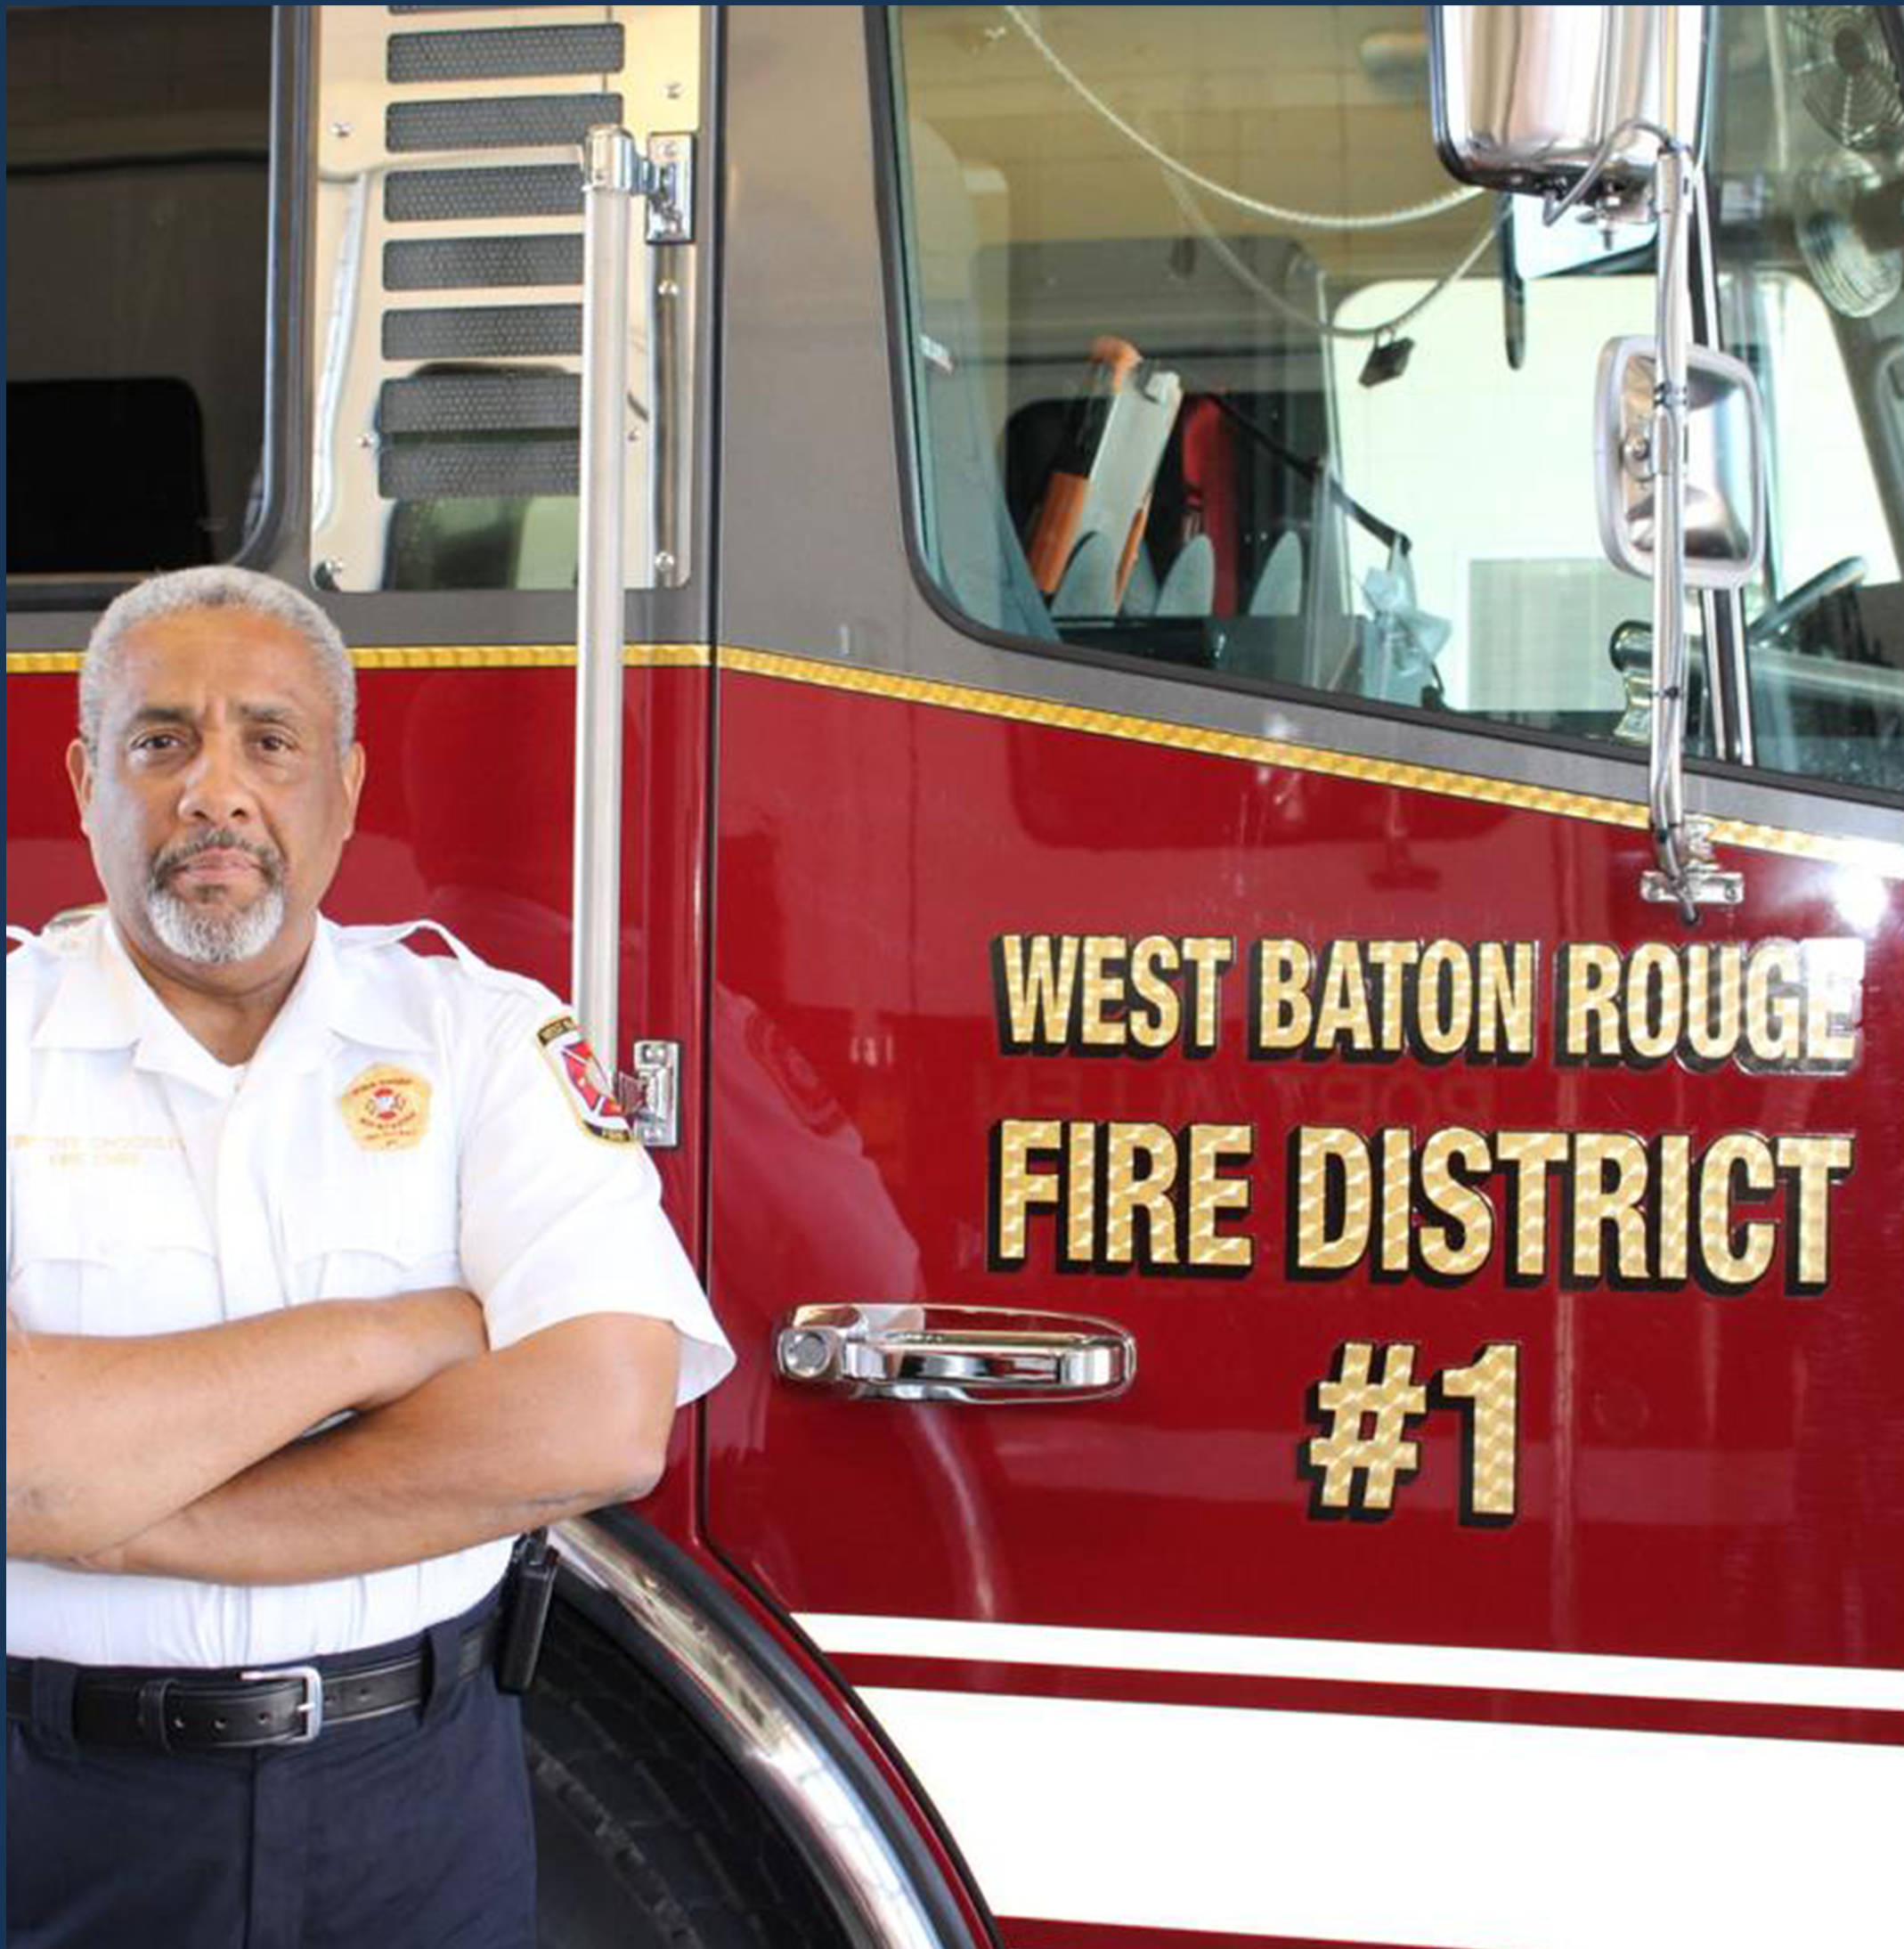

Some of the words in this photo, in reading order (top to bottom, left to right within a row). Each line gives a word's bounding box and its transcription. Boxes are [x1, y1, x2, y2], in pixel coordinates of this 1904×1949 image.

[992, 933, 1236, 1056] WEST
[1249, 937, 1541, 1067] BATON
[1553, 936, 1867, 1074] ROUGE
[988, 1120, 1257, 1281] FIRE
[1287, 1124, 1857, 1297] DISTRICT
[1298, 1341, 1523, 1526] #1
